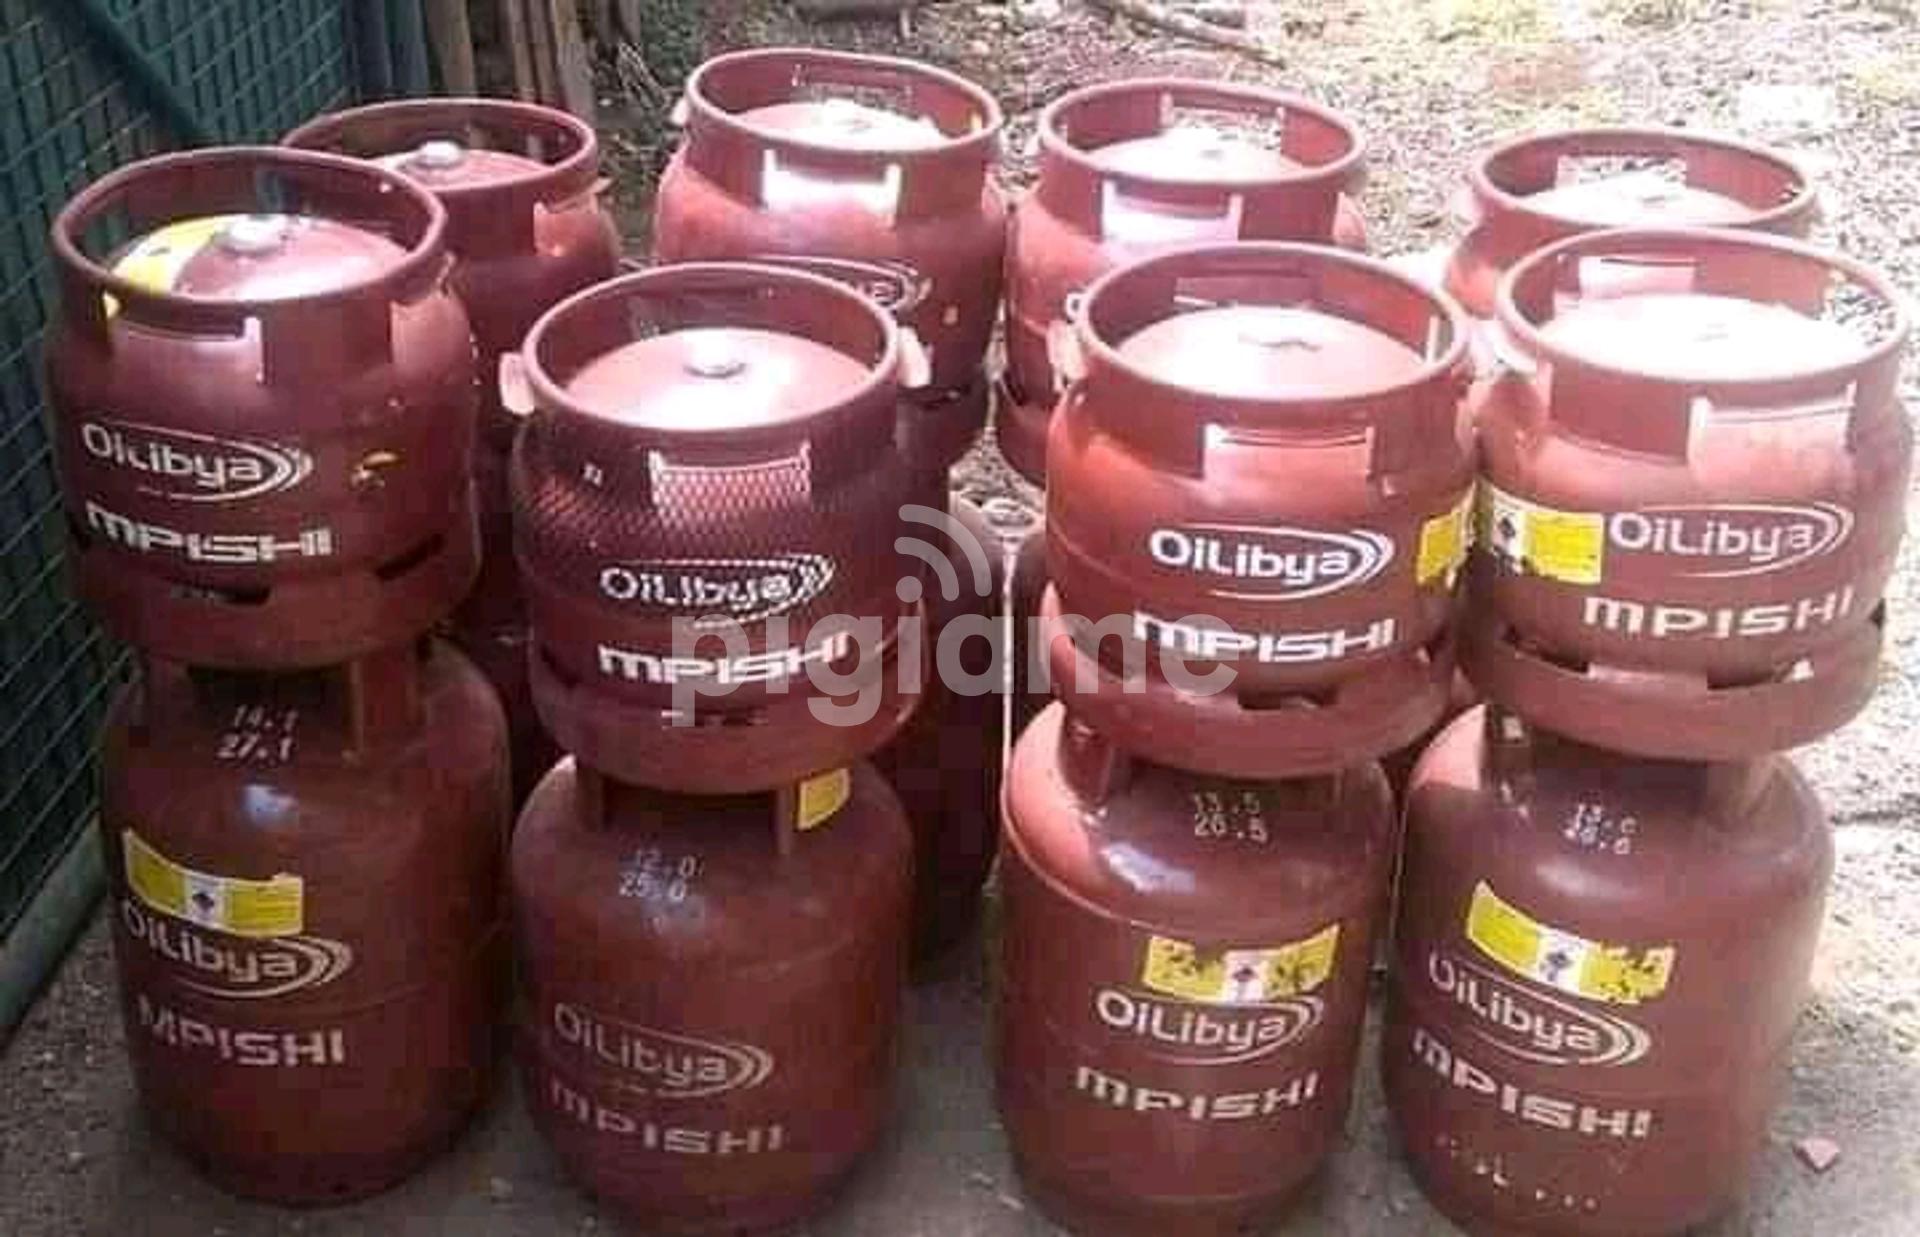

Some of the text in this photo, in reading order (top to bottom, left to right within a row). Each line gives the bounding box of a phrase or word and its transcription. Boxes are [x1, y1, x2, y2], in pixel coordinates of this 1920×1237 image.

[83, 423, 263, 488] OiLibya
[86, 500, 332, 562] MPISHI
[1150, 529, 1353, 586] OiLibya
[1610, 512, 1815, 563] OiLibya
[601, 567, 792, 611] OiLibya
[1583, 587, 1854, 639] MPISHI
[598, 630, 850, 685] MPISHI
[1133, 611, 1395, 664] MPISHI
[217, 732, 292, 762] 27.1
[124, 898, 299, 982] OiLibya
[138, 994, 345, 1067] MPISHI
[1097, 990, 1288, 1051] OiLibya
[1429, 950, 1600, 1052] OiLibya
[555, 1002, 729, 1087] OiLibya
[1075, 1066, 1319, 1121] MPISHI
[1412, 1029, 1652, 1138] MPISHI
[551, 1080, 785, 1154] MPISHI
